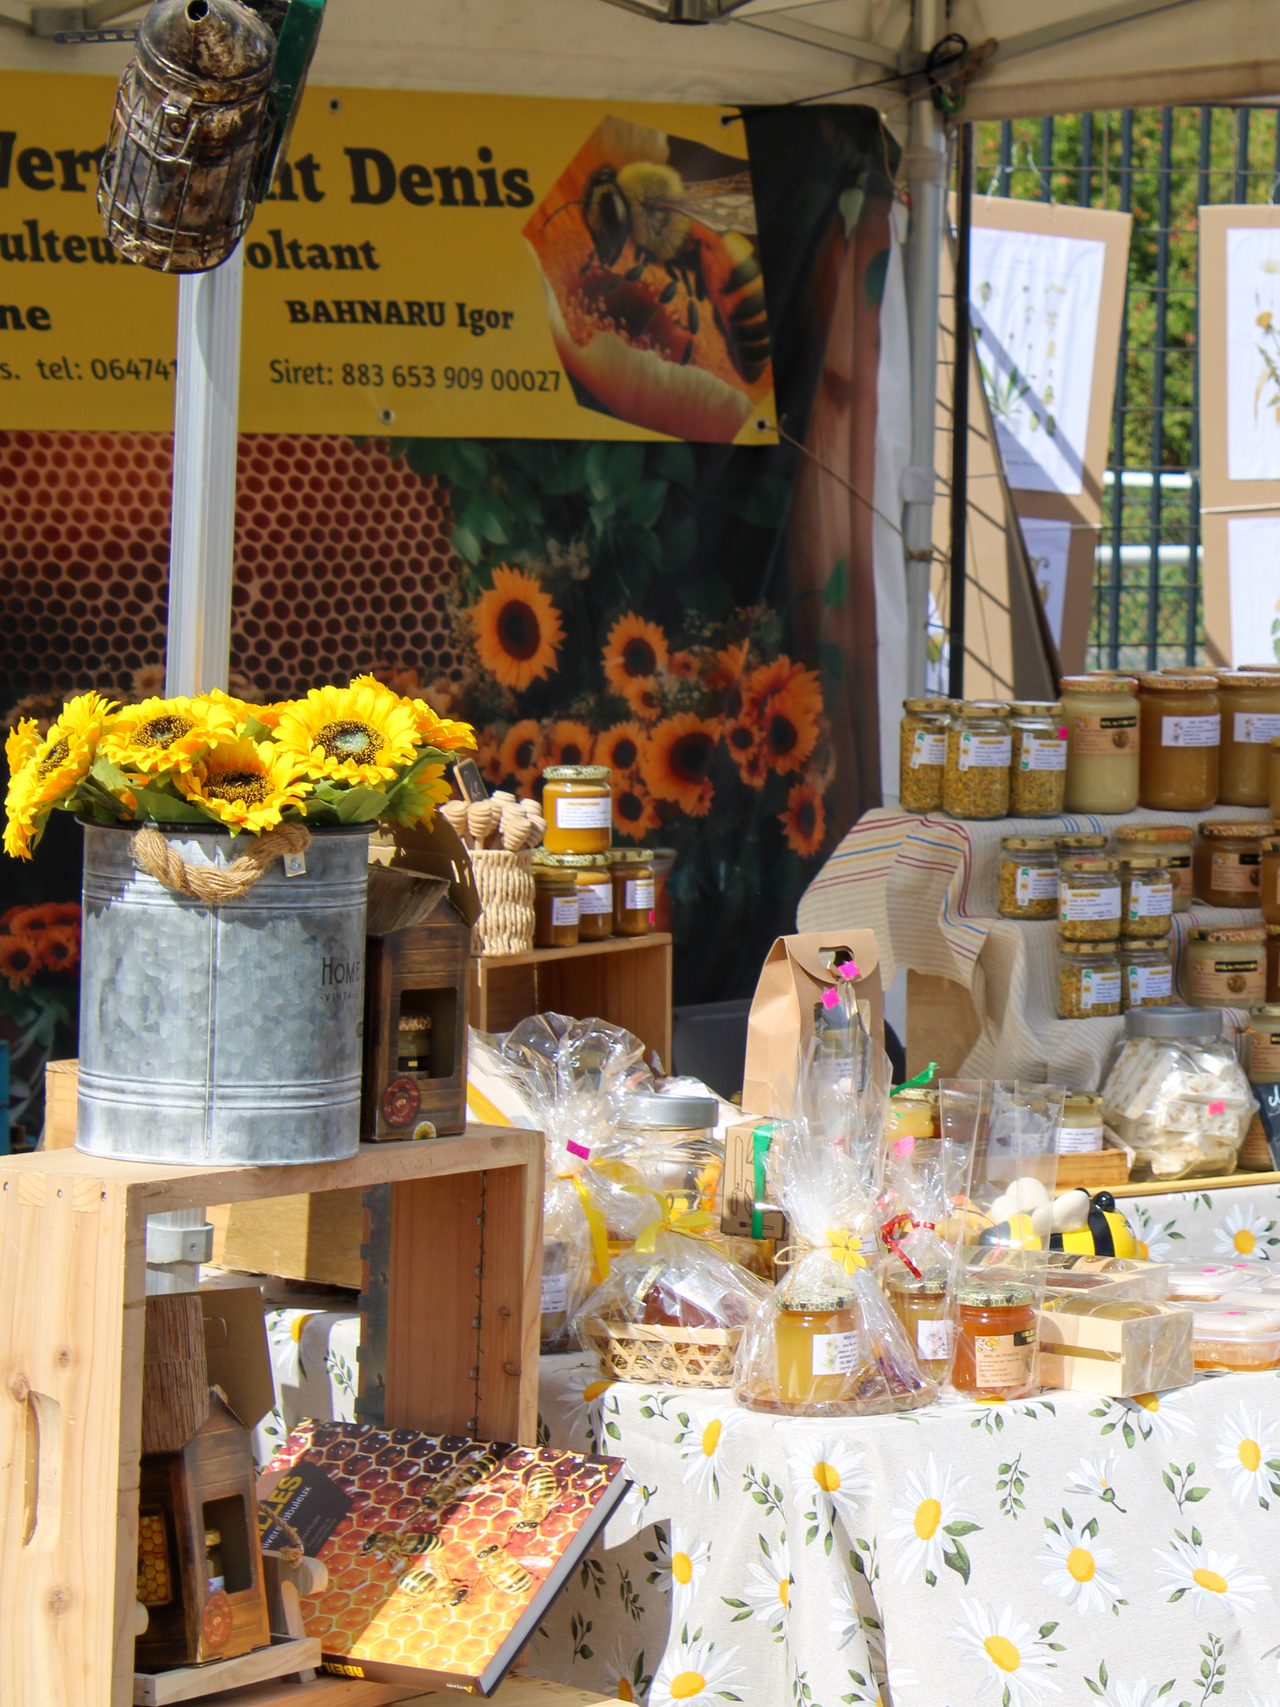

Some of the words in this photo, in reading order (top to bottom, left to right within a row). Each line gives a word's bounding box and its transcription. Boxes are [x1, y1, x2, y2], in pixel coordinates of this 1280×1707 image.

[343, 146, 535, 208] Denis
[285, 300, 446, 327] BAHNARU
[455, 302, 514, 336] Igor
[36, 356, 83, 381] tel:
[269, 359, 333, 386] Siret:
[341, 363, 384, 386] 883
[392, 365, 436, 388] 653
[443, 367, 484, 390] 909
[491, 369, 561, 392] 00027
[321, 956, 361, 986] HOME
